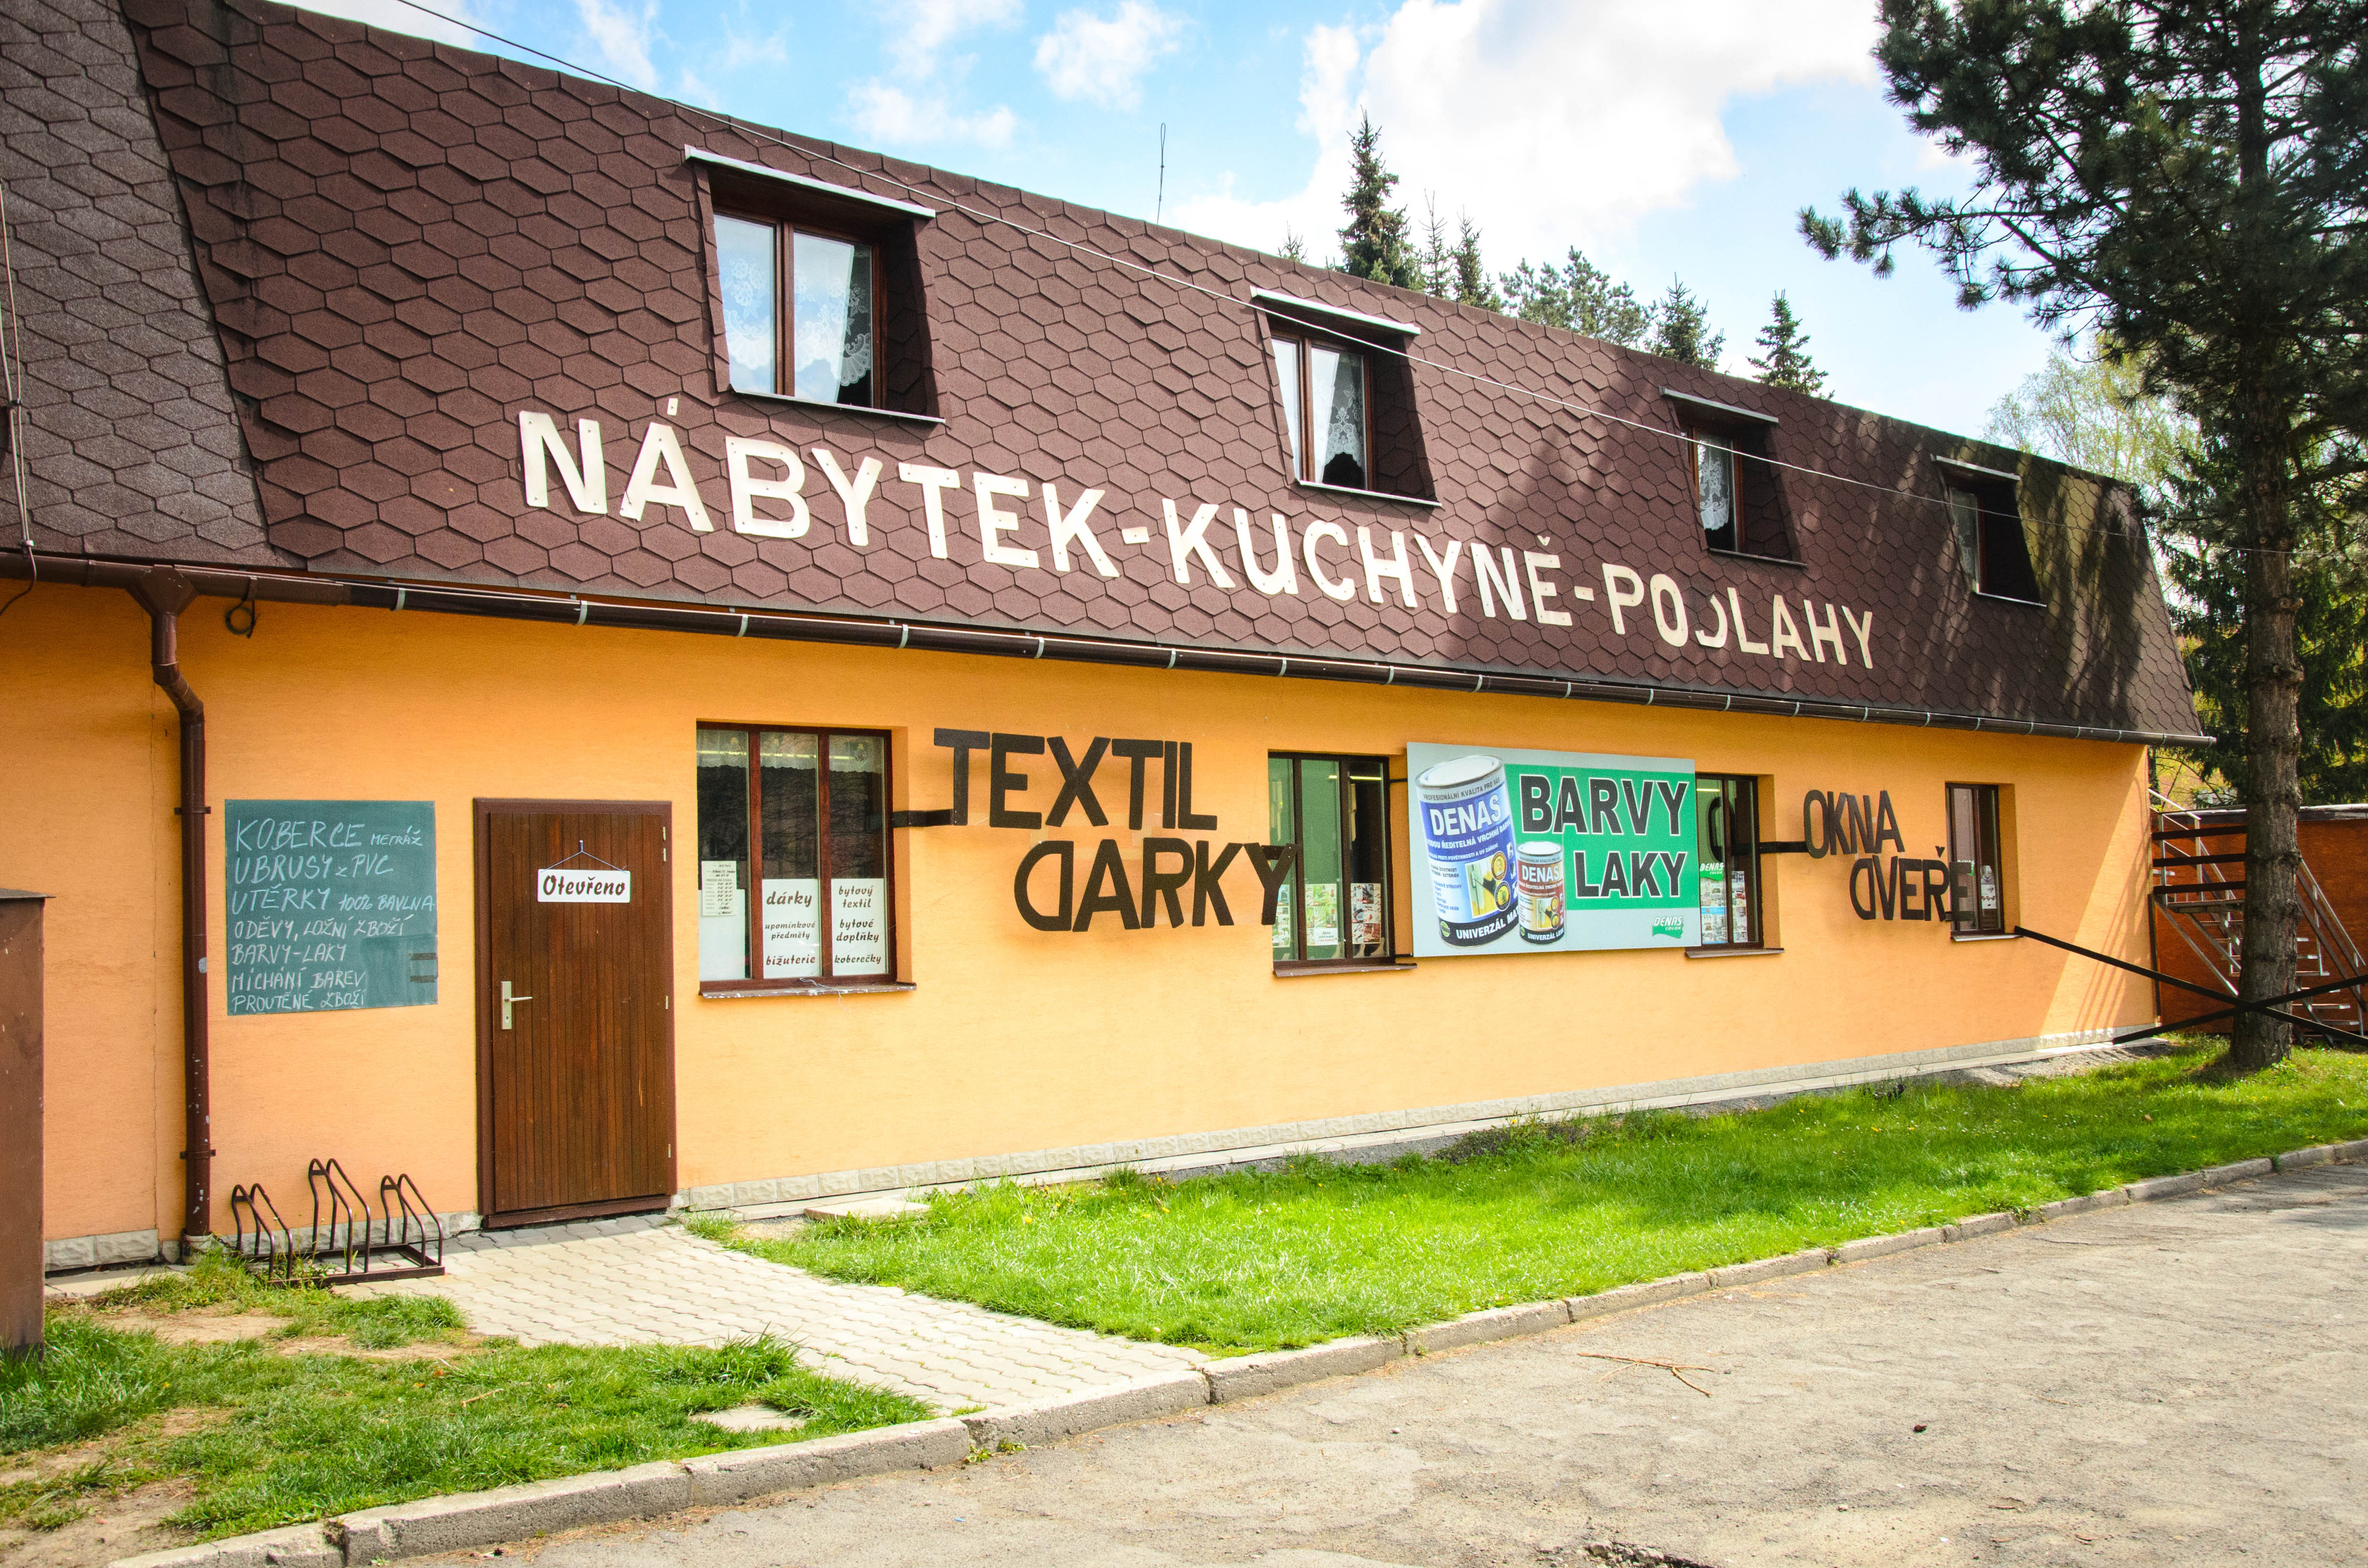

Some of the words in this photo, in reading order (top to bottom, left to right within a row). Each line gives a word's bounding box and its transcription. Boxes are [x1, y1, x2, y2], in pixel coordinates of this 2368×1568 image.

[934, 727, 1217, 830] TEXTIL
[1461, 787, 1483, 797] KVALITA
[1484, 781, 1493, 791] PRO
[1429, 793, 1501, 836] DENAS
[1519, 774, 1691, 836] BARVY
[1803, 789, 1905, 859] OKNA
[236, 818, 365, 851] KOBERCE
[371, 825, 423, 846] METRÁŽ
[1442, 837, 1476, 849] ŘEDITELNÁ
[1477, 829, 1499, 843] VRCHNÍ
[235, 854, 333, 884] UBRUSY
[352, 853, 394, 878] PVC
[1521, 864, 1559, 883] DENAS
[1574, 851, 1688, 899] LAKY
[1700, 862, 1724, 871] DENAS
[542, 874, 625, 896] Otevřeno
[838, 885, 874, 897] bytový
[1014, 837, 1299, 932] DARKY
[1849, 846, 1976, 923] DVEŘE
[378, 894, 436, 912] BAVLNA
[766, 890, 812, 907] dárky
[842, 899, 872, 908] textil
[303, 916, 353, 939] LOŽNÍ
[353, 914, 414, 936] ZBOŽÍ
[765, 920, 816, 932] upomínkové
[839, 919, 874, 930] bytové
[1456, 918, 1506, 939] UNIVERZÁL
[1653, 916, 1682, 926] DENAS
[771, 931, 810, 941] předměty
[836, 931, 879, 943] doplňky
[1527, 931, 1555, 941] UNIVERZÁL
[765, 954, 816, 966] bižuterie
[834, 954, 881, 965] koberečky
[310, 970, 365, 989] BAREV
[231, 989, 315, 1013] PROUTĚNÉ
[320, 989, 366, 1009] ZBOŽÍ
